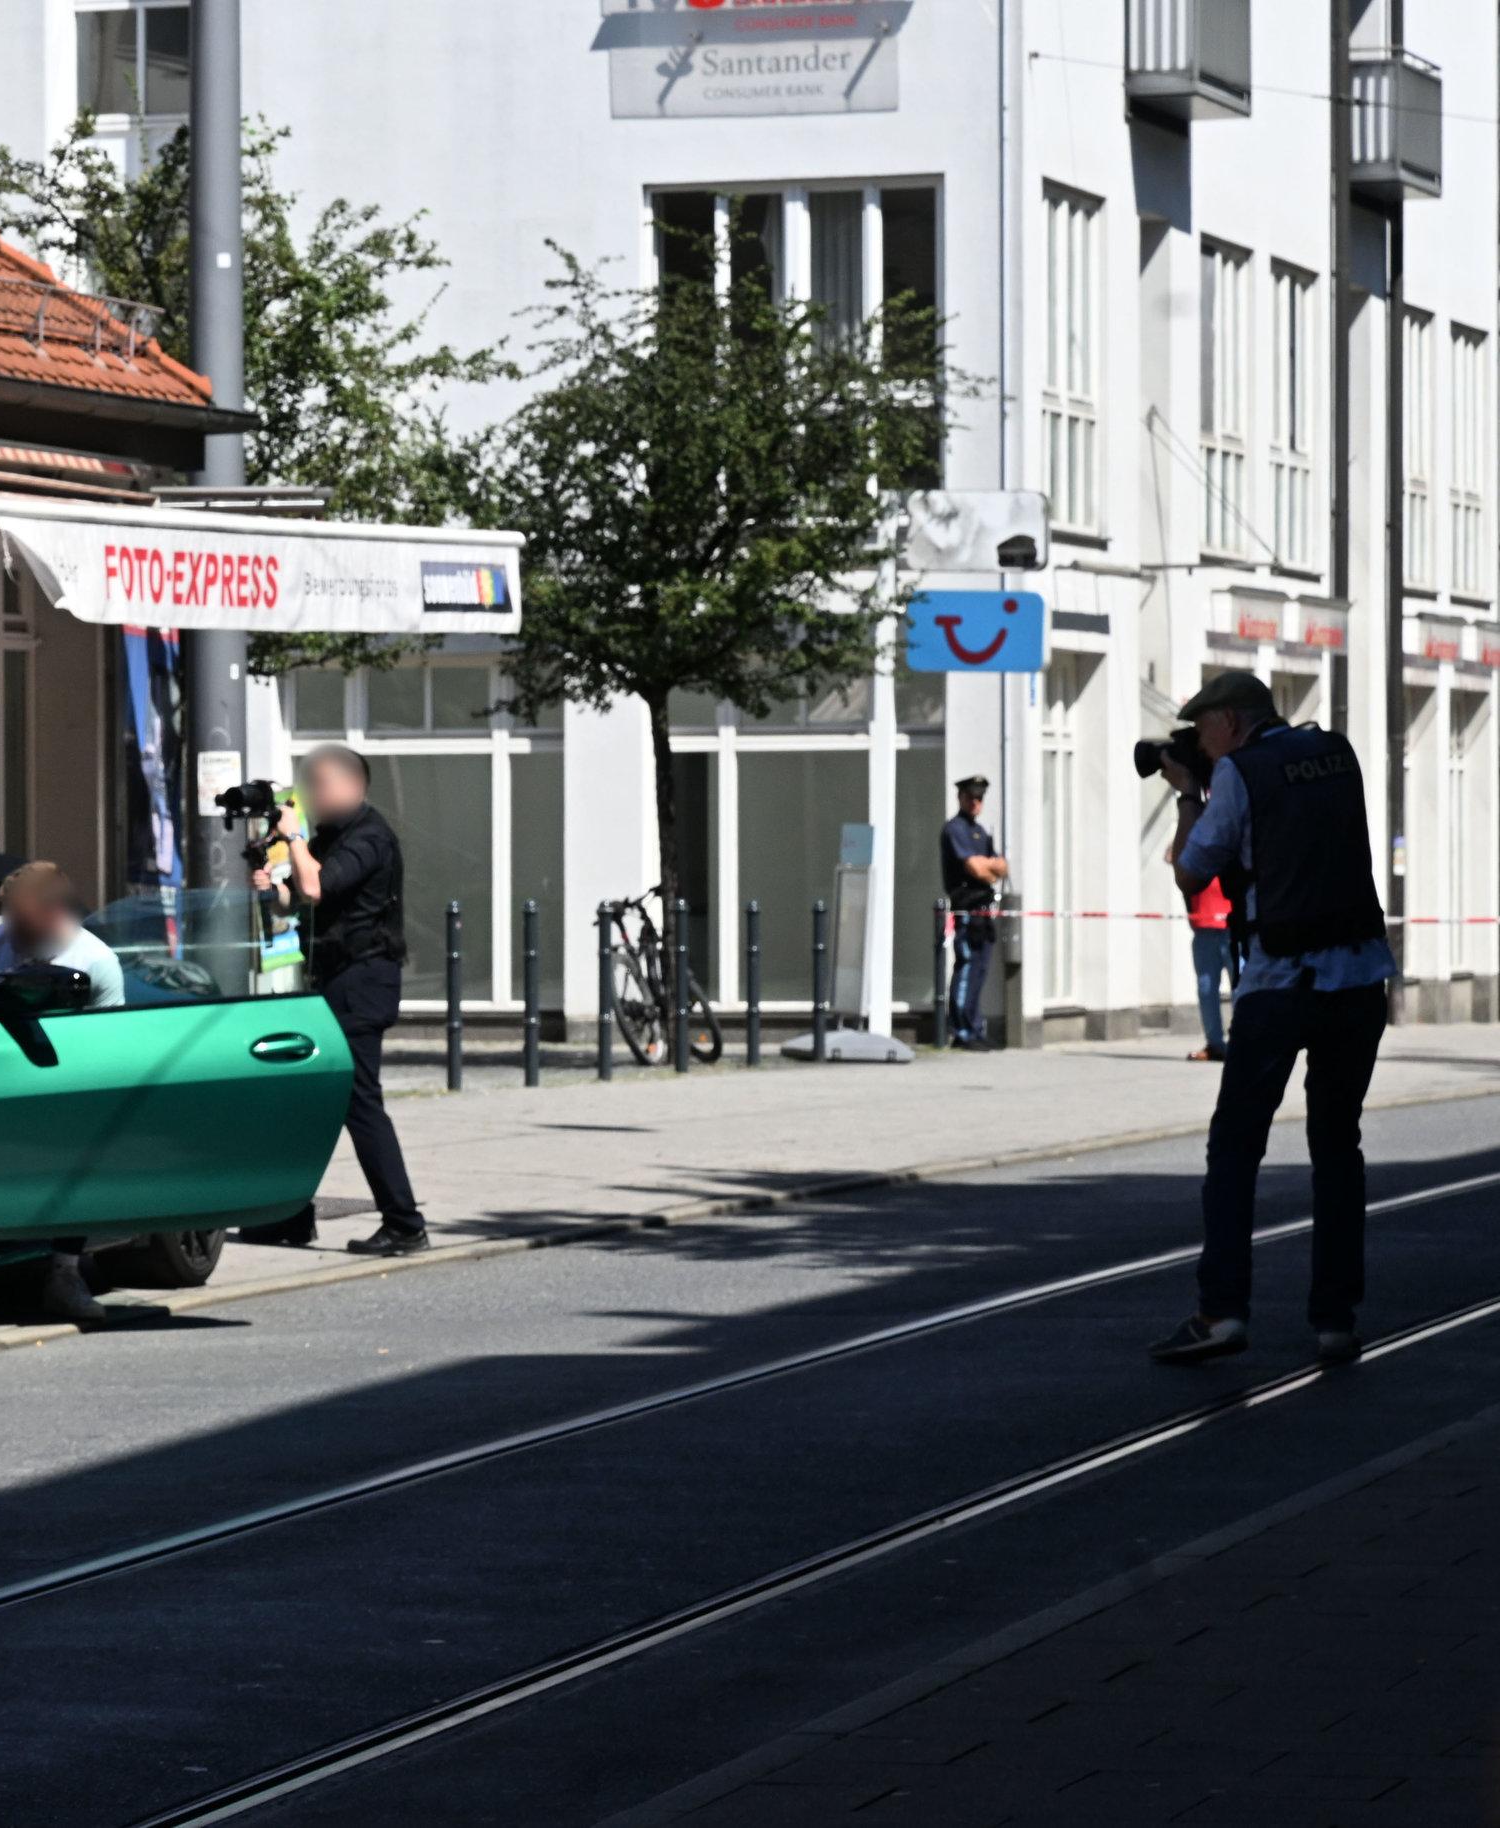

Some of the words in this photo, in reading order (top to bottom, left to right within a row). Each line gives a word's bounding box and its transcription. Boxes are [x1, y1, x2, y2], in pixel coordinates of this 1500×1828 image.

[701, 45, 852, 76] Santander
[703, 85, 782, 101] CONSUMER
[786, 83, 824, 98] BANK
[104, 545, 279, 609] FOTO-EXPRESS
